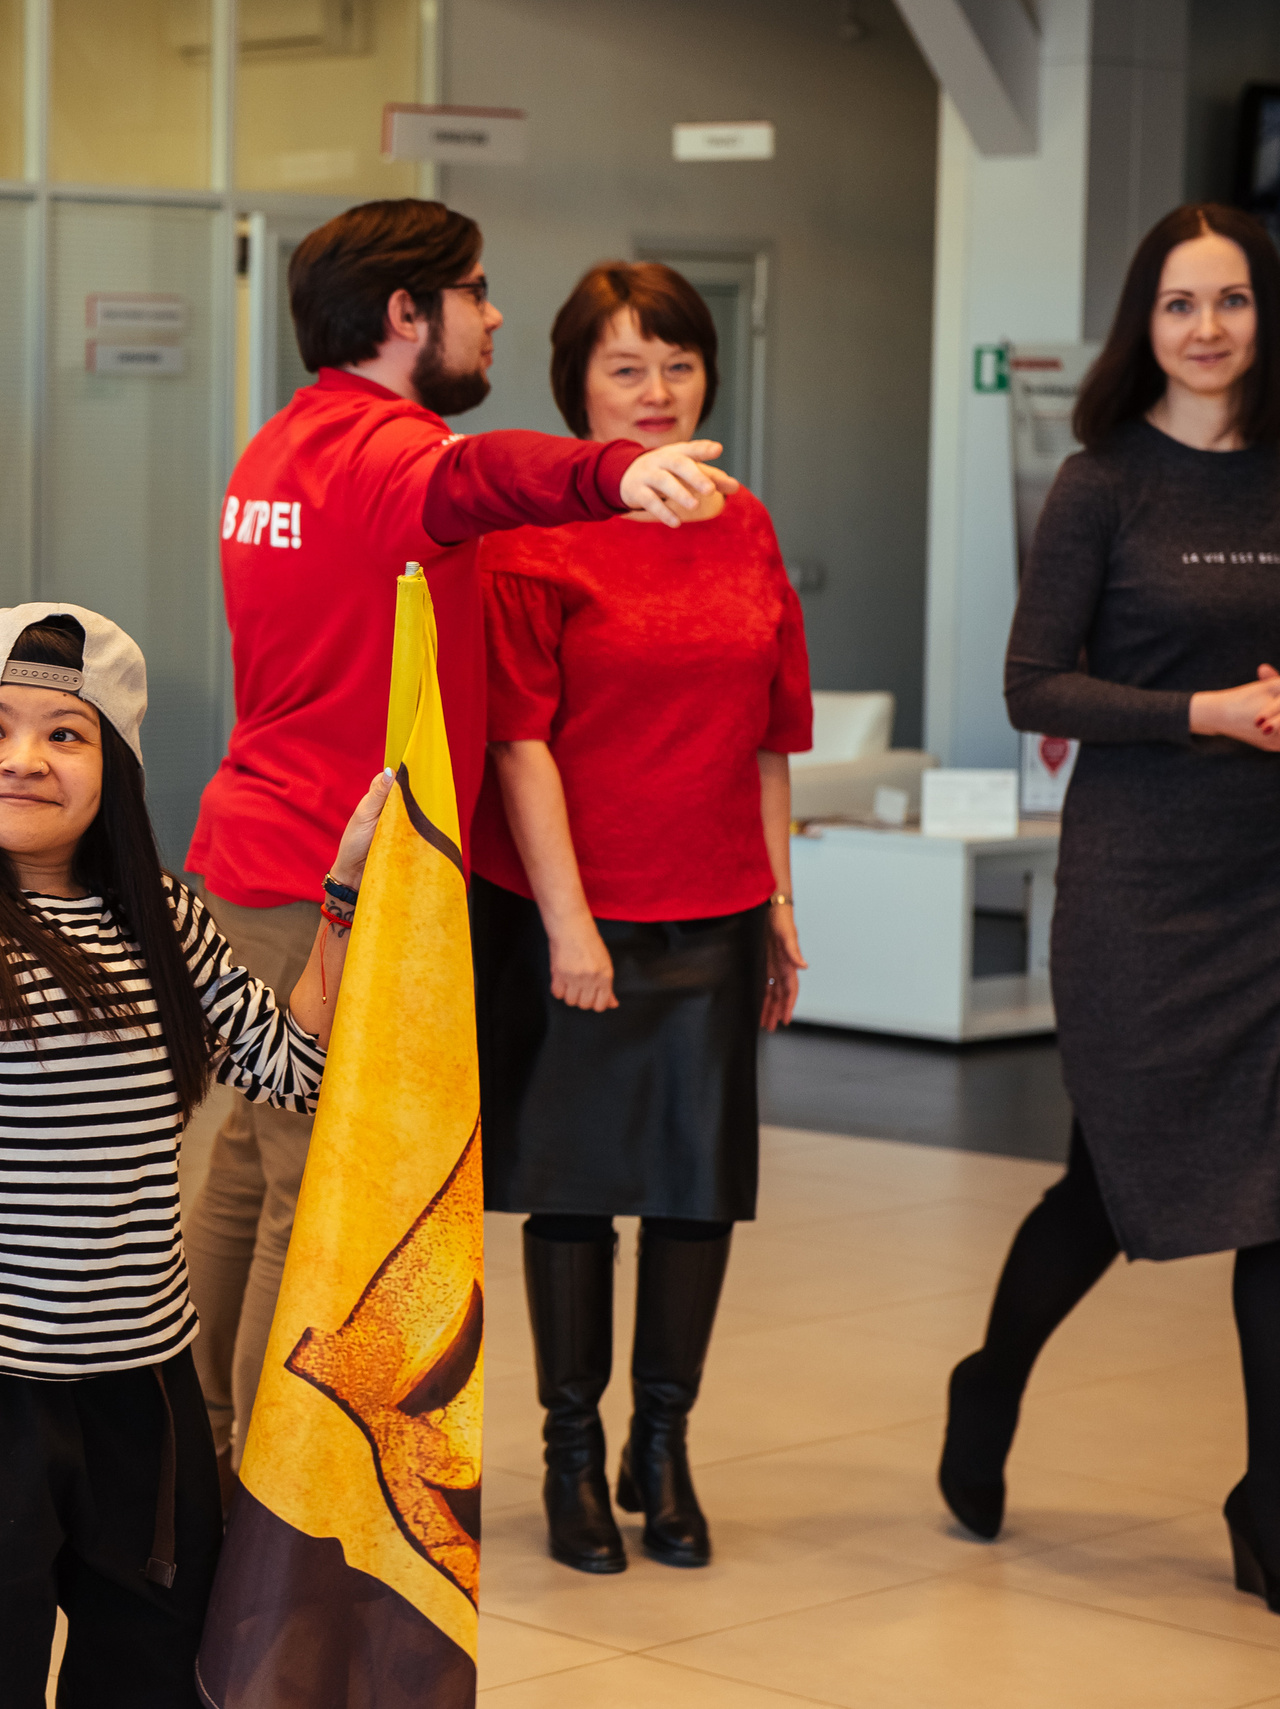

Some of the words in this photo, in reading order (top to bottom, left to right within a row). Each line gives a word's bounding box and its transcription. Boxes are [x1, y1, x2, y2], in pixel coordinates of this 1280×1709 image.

[1182, 552, 1200, 565] LA
[1203, 551, 1226, 565] VIE
[1230, 551, 1254, 565] EST
